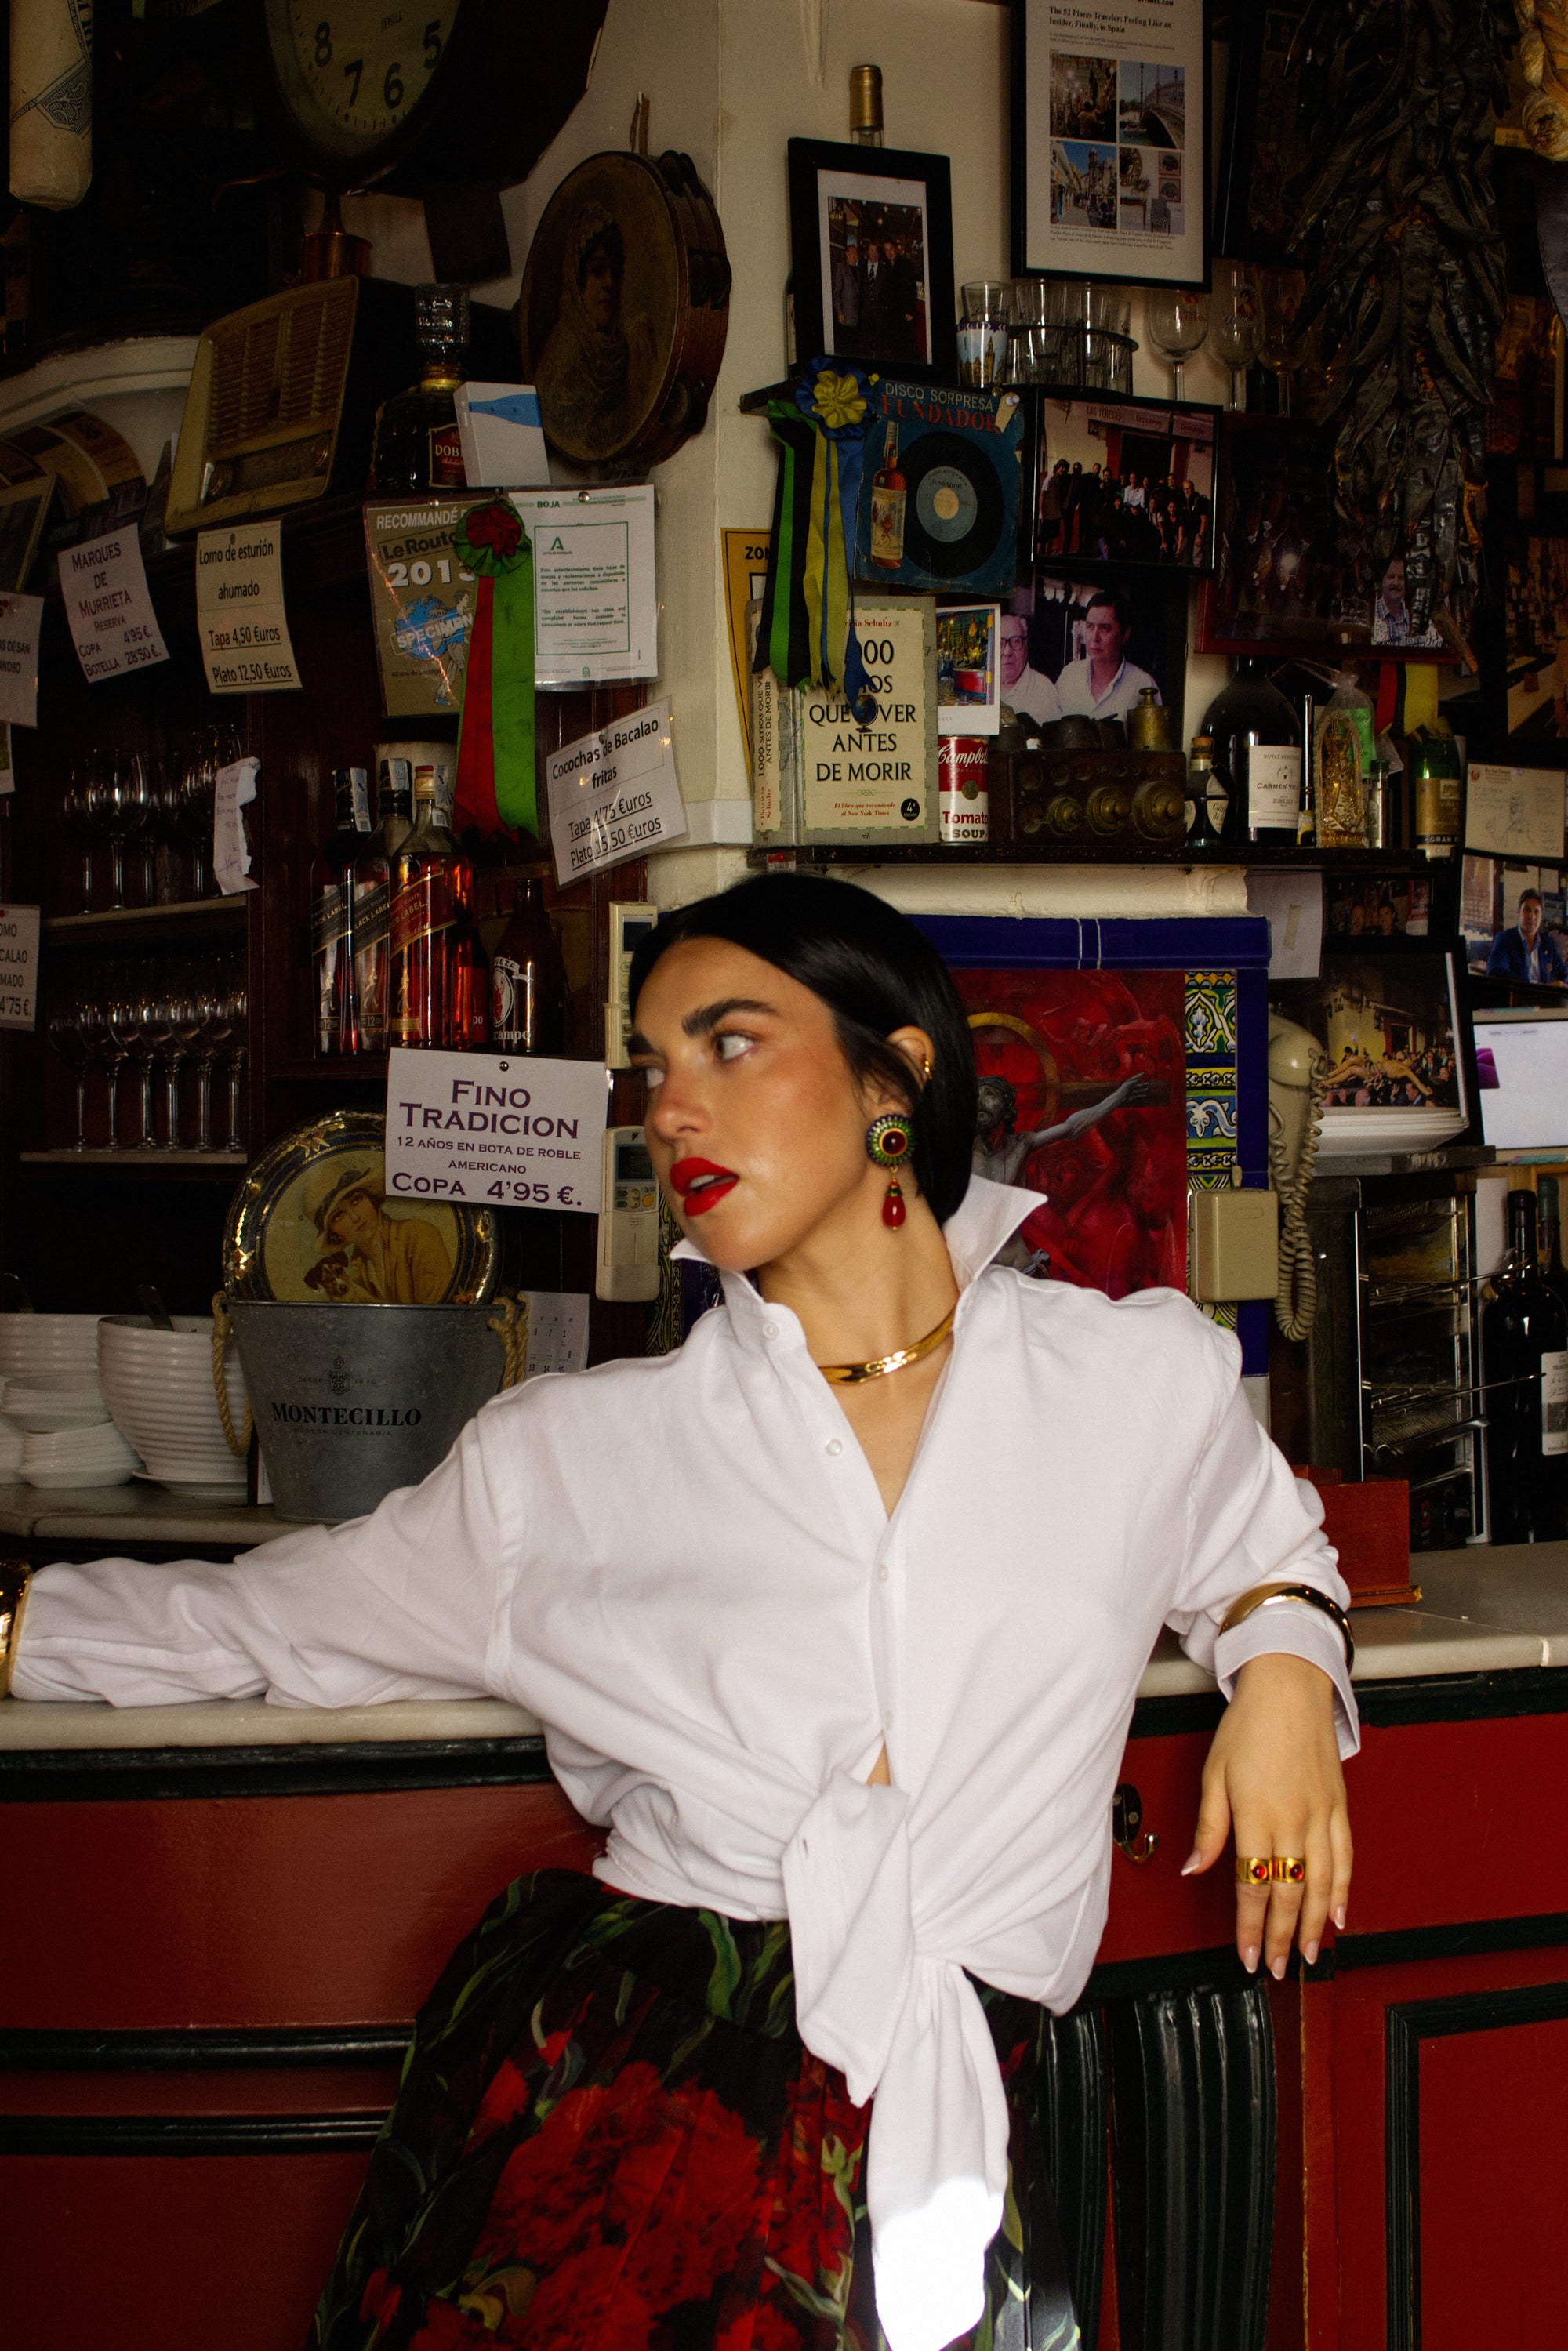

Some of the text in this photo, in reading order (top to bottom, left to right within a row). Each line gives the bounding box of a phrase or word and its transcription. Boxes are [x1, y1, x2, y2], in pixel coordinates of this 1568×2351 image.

[1073, 9, 1092, 18] Places
[1149, 18, 1162, 27] Like
[1108, 24, 1126, 34] Spain
[314, 20, 441, 109] 8 7 6 5
[884, 383, 994, 412] DISCO SORPRESA
[881, 394, 1002, 434] FUNDADOR
[435, 444, 461, 457] DOB
[536, 500, 561, 509] BOJA
[376, 506, 459, 530] RECOMMANDÉ
[72, 542, 122, 572] MARQUES
[199, 538, 274, 565] Lomo de esturión
[93, 571, 108, 590] DE
[218, 579, 260, 600] ahumado
[79, 589, 132, 619] MURRIETA
[93, 615, 127, 633] RESERVA
[78, 642, 102, 658] COPA
[124, 626, 143, 644] 4'95
[209, 626, 281, 650] Tapa 4,50 €uros
[84, 658, 122, 677] BOTELLA
[125, 646, 151, 666] 28'50
[212, 662, 292, 683] Plato 12,50 €uros
[765, 717, 771, 731] DE
[809, 704, 916, 727] QUE VER
[552, 719, 659, 780] Cocochas de Bacalao
[832, 733, 897, 753] ANTES
[592, 765, 618, 790] fritas
[816, 762, 912, 782] DE MORIR
[568, 791, 652, 839] Tapa 4'75 €uros
[570, 844, 593, 868] Plato
[627, 817, 662, 840] €uros
[952, 829, 985, 839] SOUP
[451, 1079, 532, 1109] FINO
[398, 1101, 579, 1140] TRADICION
[397, 1136, 582, 1160] 12 AÑOS EN BOTA DE ROBLE
[448, 1159, 528, 1174] AMERICANO
[391, 1172, 466, 1196] COPA
[486, 1179, 550, 1203] 4'95
[271, 1402, 423, 1427] MONTECILLO
